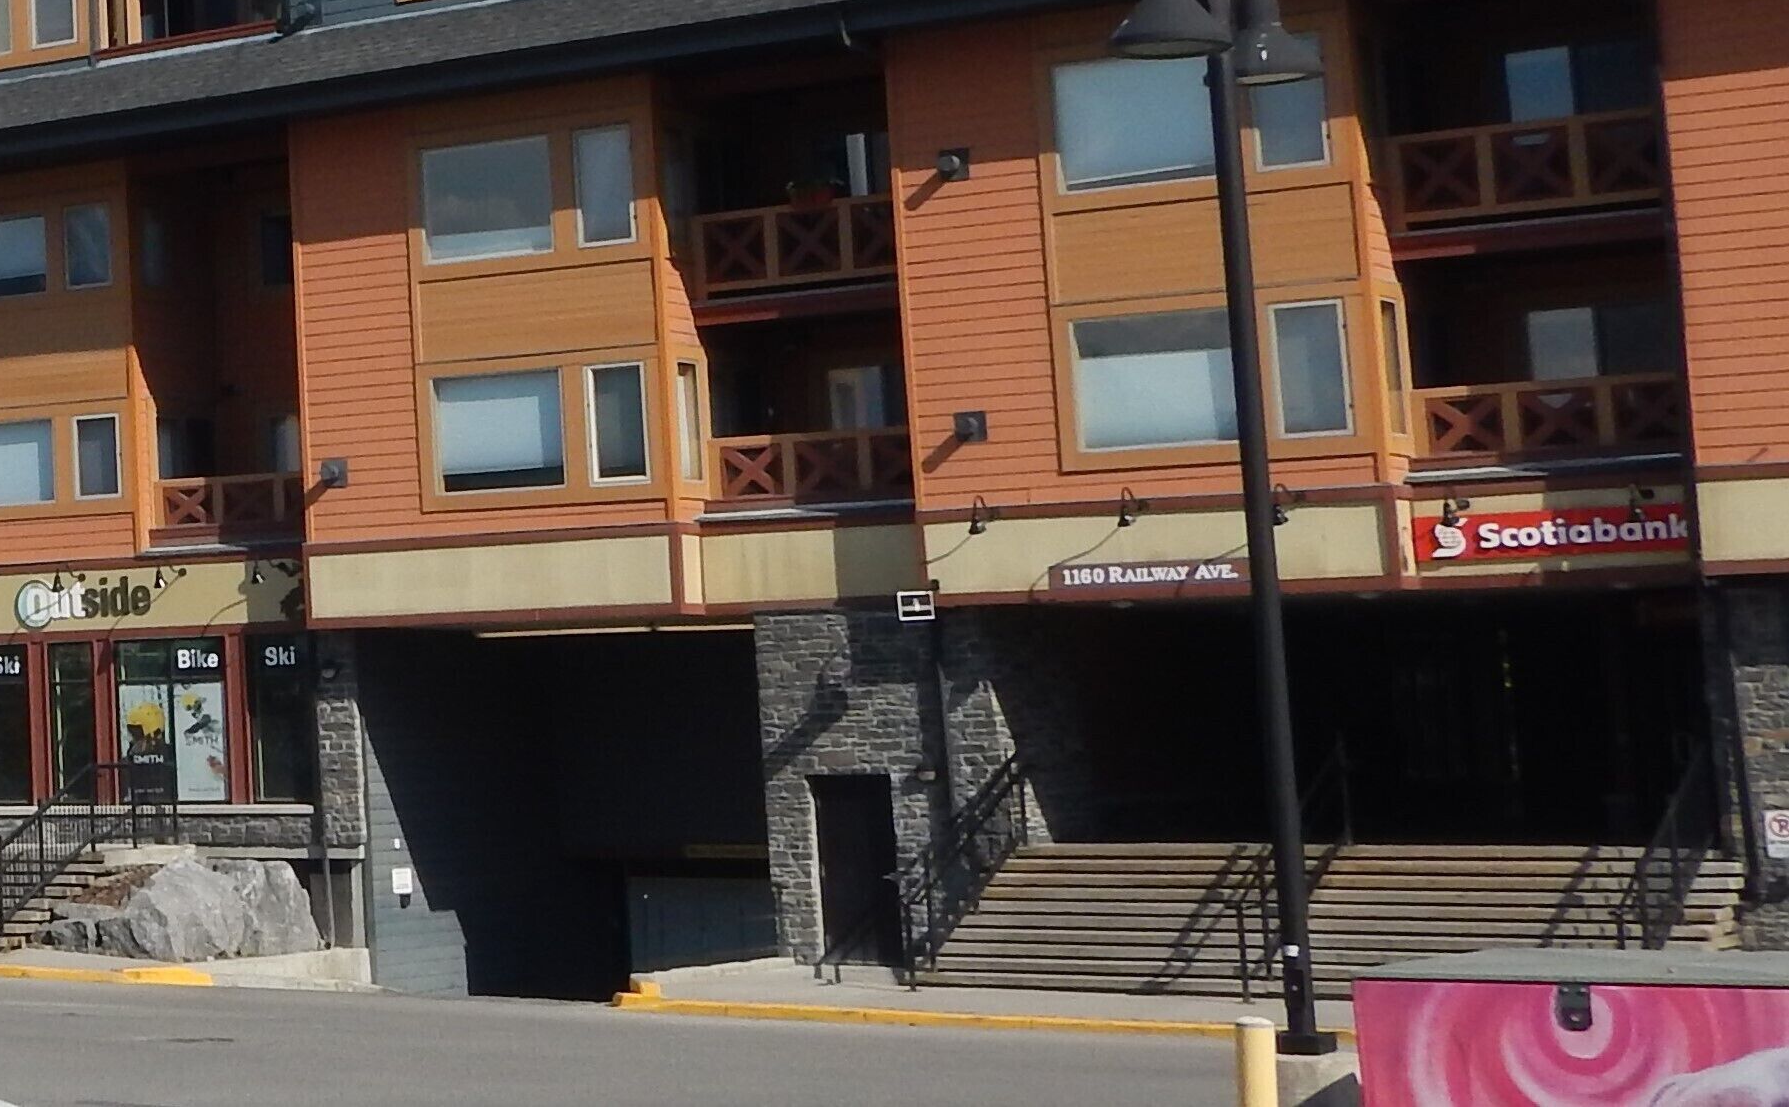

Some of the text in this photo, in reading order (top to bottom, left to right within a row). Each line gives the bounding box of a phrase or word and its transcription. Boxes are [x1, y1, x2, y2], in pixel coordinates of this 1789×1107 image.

[1477, 512, 1688, 549] Scotiabank
[1062, 568, 1105, 585] 1160
[1107, 565, 1191, 584] RAILWAY
[16, 576, 152, 628] Outside
[177, 648, 220, 669] Bike
[265, 645, 297, 667] Ski
